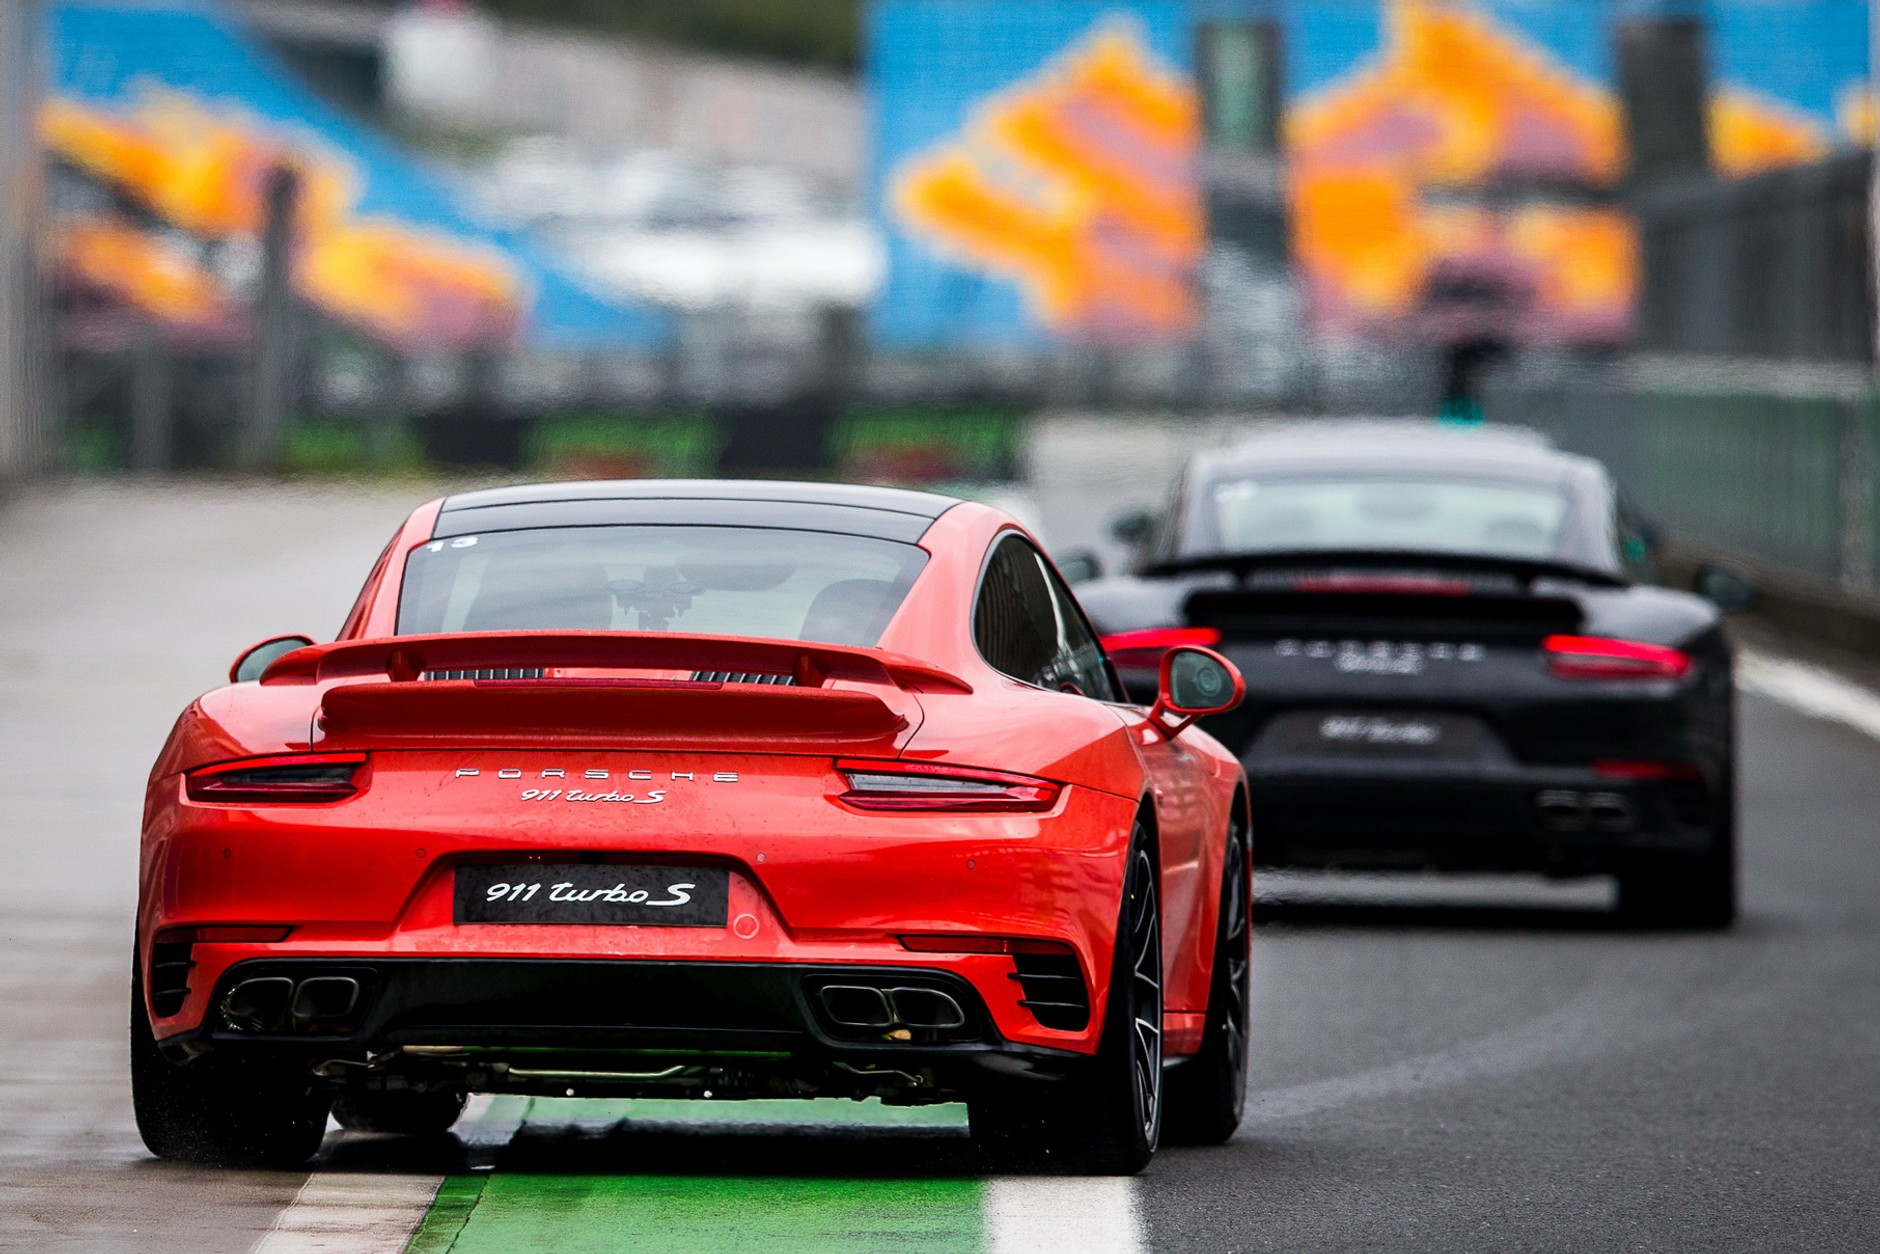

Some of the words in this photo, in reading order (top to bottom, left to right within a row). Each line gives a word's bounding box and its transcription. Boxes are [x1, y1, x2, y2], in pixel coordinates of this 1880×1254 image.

[454, 767, 740, 783] PORSCHE
[521, 788, 563, 801] 911
[565, 789, 635, 802] turbo
[633, 790, 667, 804] S
[486, 882, 542, 902] 911
[549, 882, 649, 903] turbo
[645, 883, 697, 907] S
